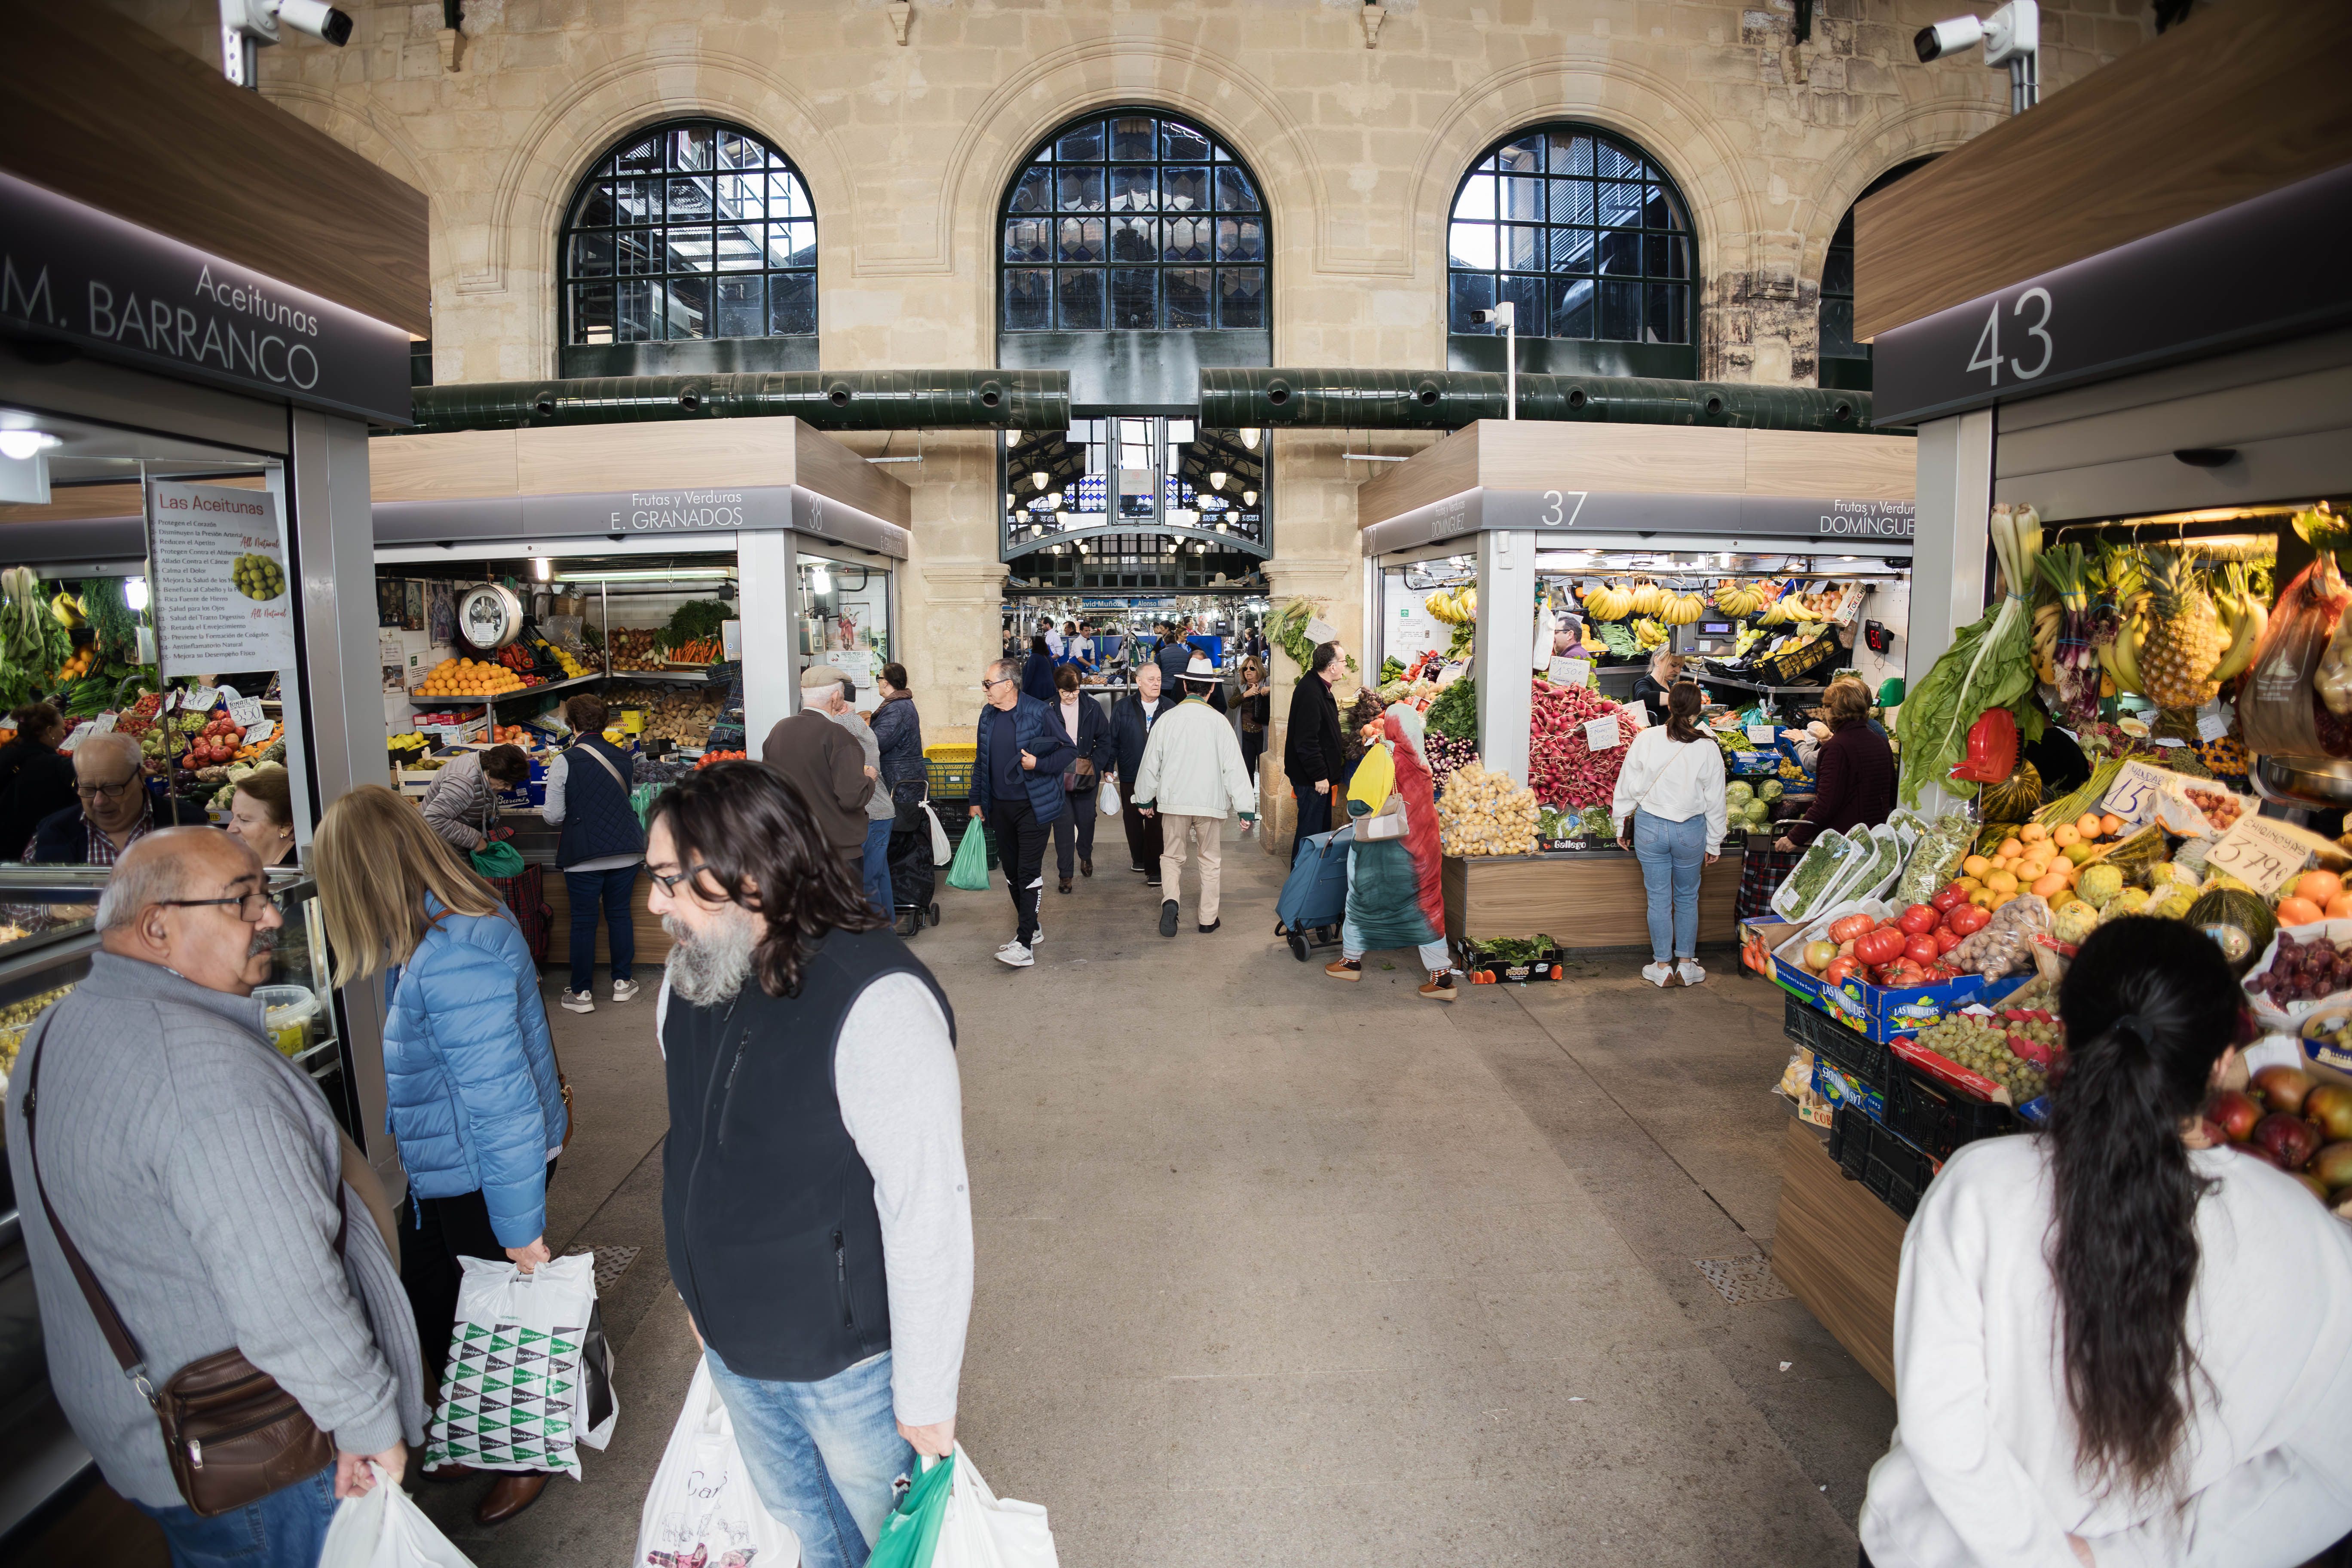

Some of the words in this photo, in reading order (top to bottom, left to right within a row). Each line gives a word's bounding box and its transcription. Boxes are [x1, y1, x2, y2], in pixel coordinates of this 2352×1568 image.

[196, 264, 318, 337] Aceitunas
[2, 254, 68, 328] M.
[89, 280, 318, 389] BARRANCO
[1966, 287, 2053, 386] 43
[160, 493, 188, 509] Las
[193, 495, 264, 516] Aceitunas
[632, 493, 670, 506] Frutas
[674, 496, 680, 508] y
[684, 490, 742, 505] Verduras
[1435, 505, 1445, 517] Frutas
[1449, 499, 1465, 513] Verduras
[1542, 490, 1588, 526] 37
[1834, 499, 1867, 513] Frutas
[1871, 505, 1876, 516] y
[611, 512, 626, 530] E.
[632, 507, 743, 530] GRANADOS
[809, 495, 822, 531] 38
[1369, 527, 1377, 553] 37
[251, 608, 262, 619] All
[230, 698, 250, 708] TOMATE
[1554, 840, 1586, 850] Gallego
[2243, 819, 2306, 856] CHIRINOYAS
[1822, 984, 1834, 997] LAS
[1834, 988, 1865, 1018] VIRTUDES
[1894, 1006, 1906, 1016] LAS
[1906, 1006, 1939, 1016] VIRTUDES
[1822, 1066, 1850, 1099] VIRTUDES
[1850, 1092, 1861, 1106] LAS
